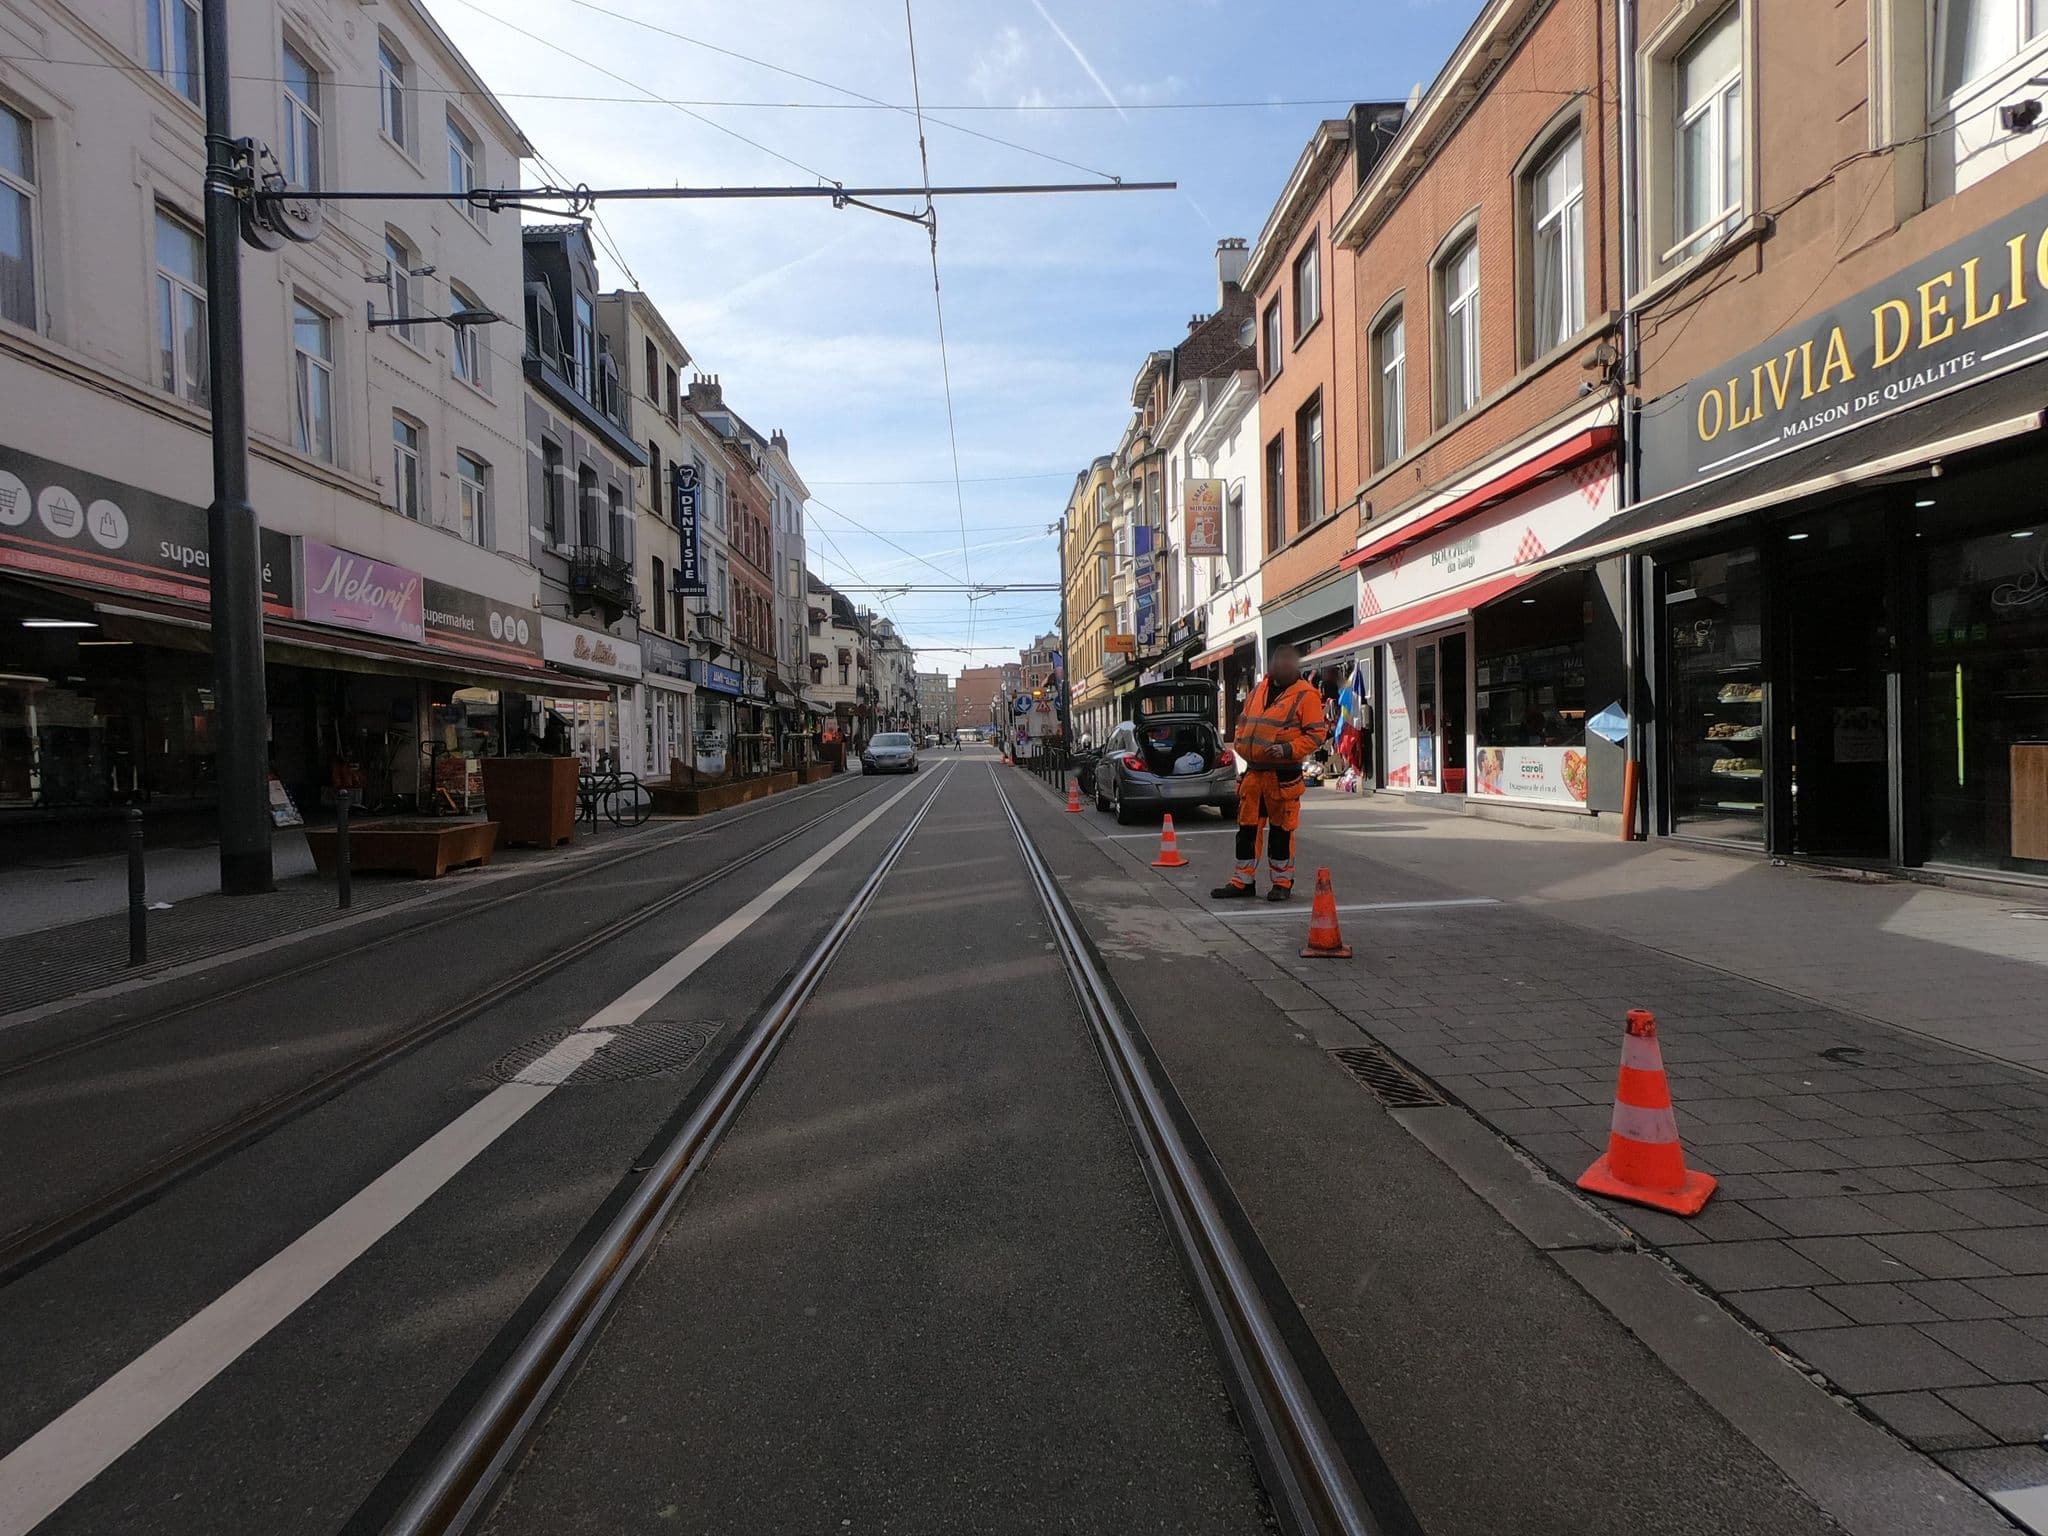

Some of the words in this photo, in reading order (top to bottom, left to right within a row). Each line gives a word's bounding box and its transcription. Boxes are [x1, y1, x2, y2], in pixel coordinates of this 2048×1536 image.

[1697, 326, 1855, 442] OLIVIA
[1783, 404, 1849, 439] MAISON
[1854, 390, 1880, 413] DE
[1884, 350, 1976, 401] QUALITE
[681, 495, 695, 579] DENTISTE
[313, 555, 417, 623] Nekorif
